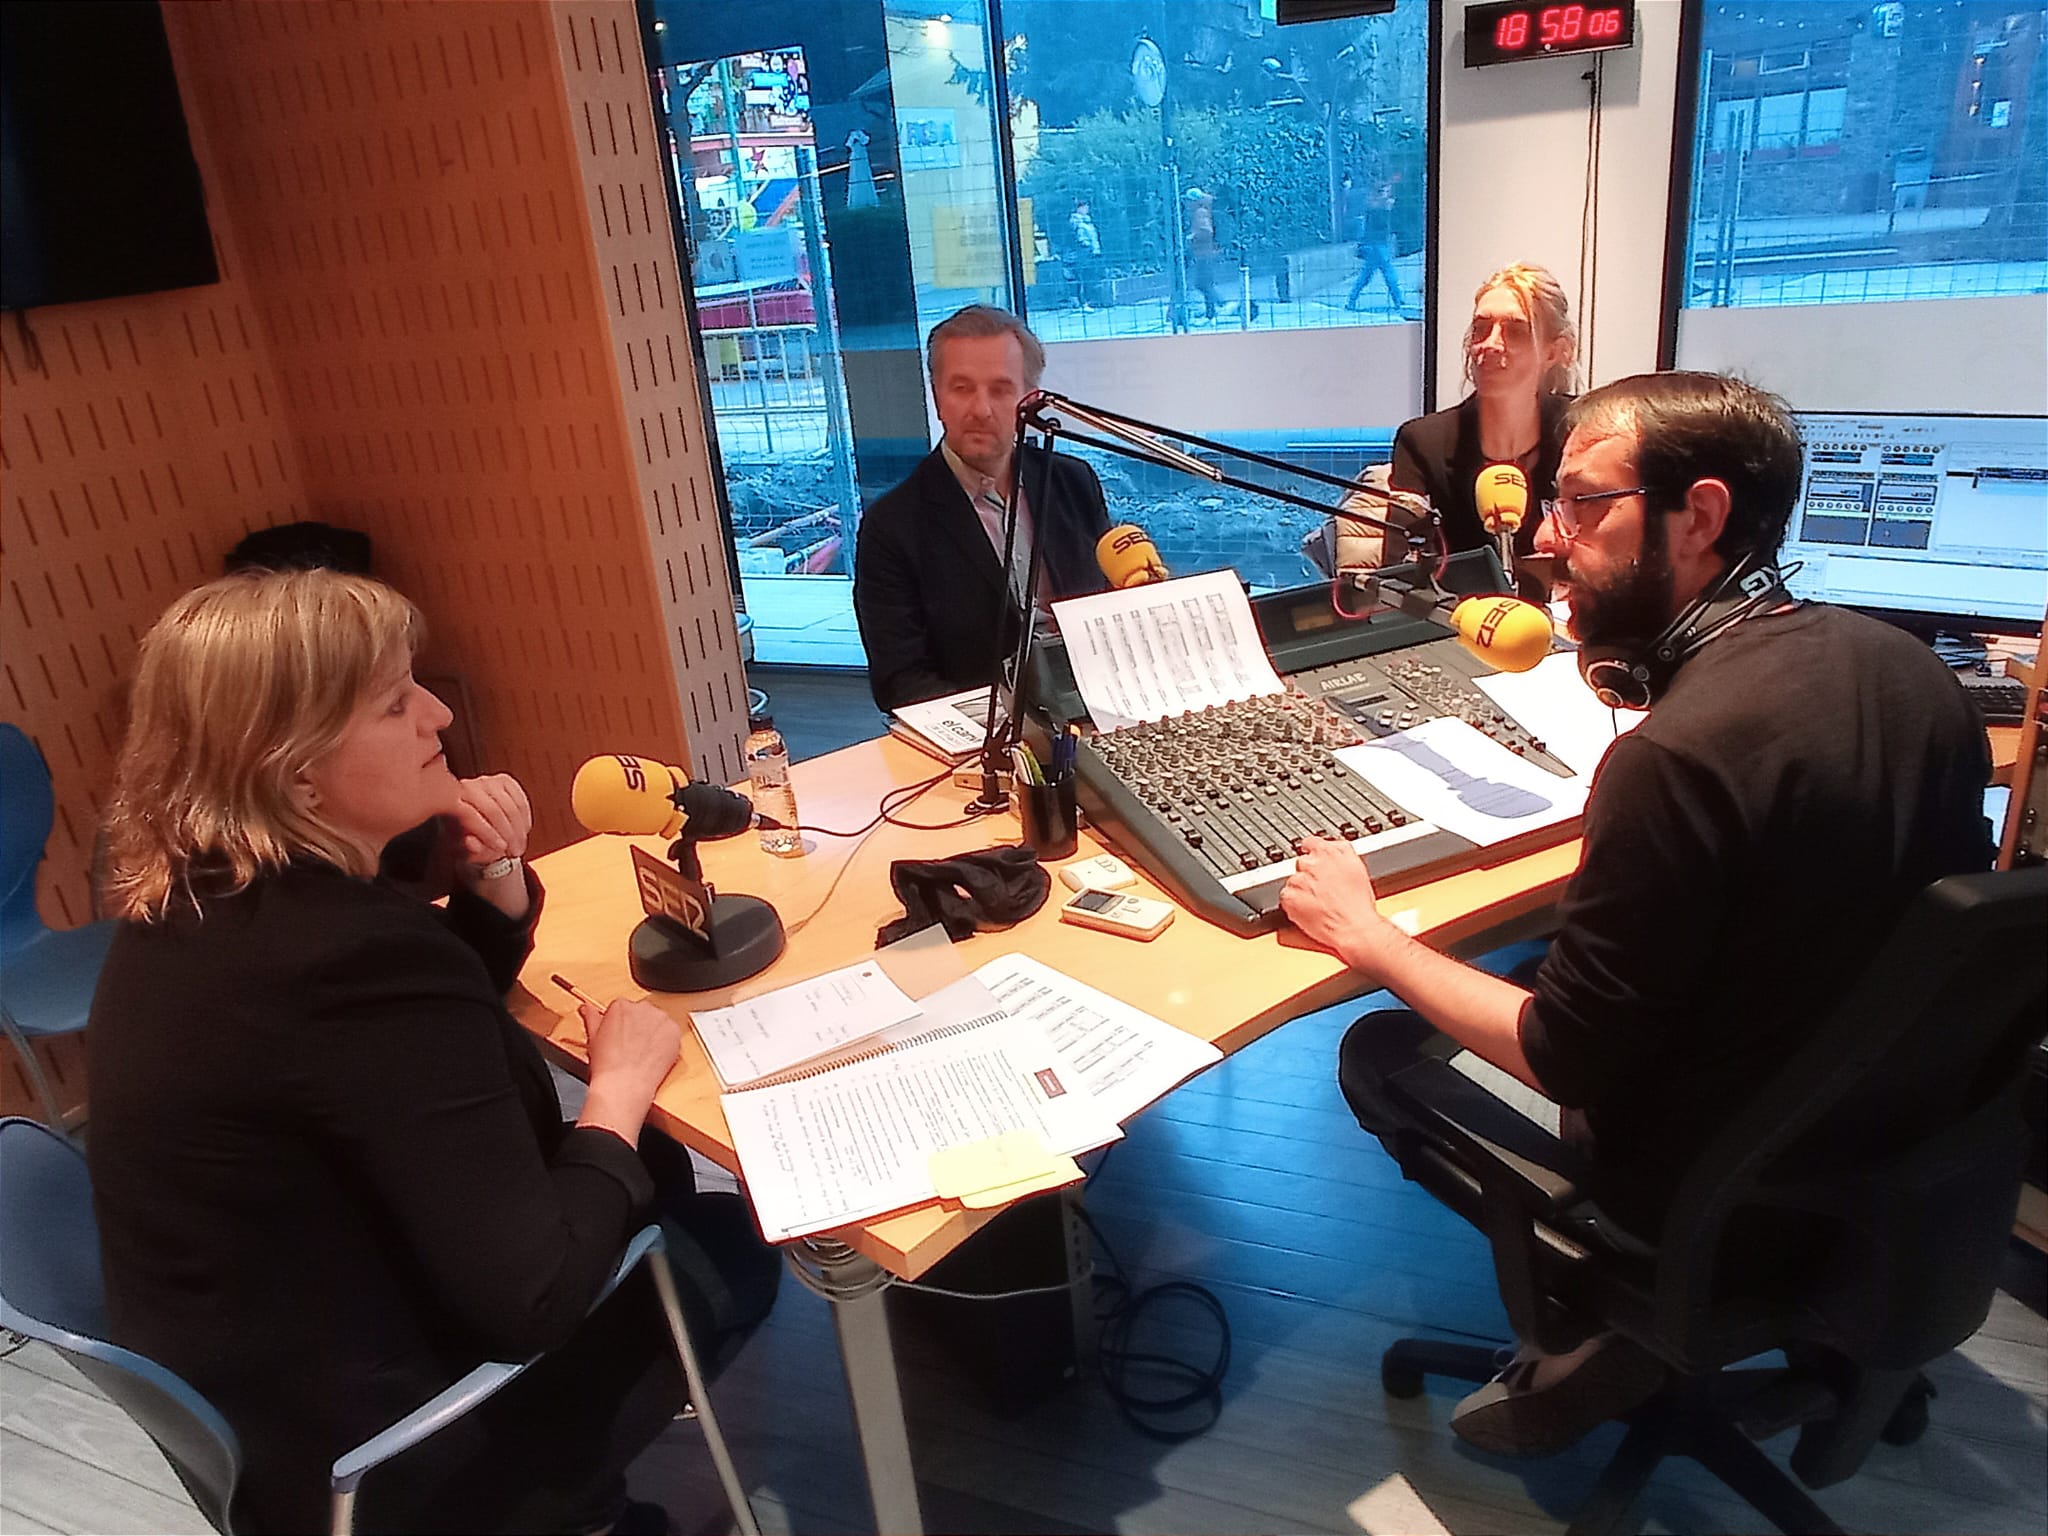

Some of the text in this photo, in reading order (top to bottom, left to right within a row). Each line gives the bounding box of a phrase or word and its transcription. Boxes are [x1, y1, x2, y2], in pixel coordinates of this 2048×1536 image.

[1497, 5, 1620, 46] 18 58 06
[1476, 599, 1521, 648] SER
[639, 866, 710, 941] SER
